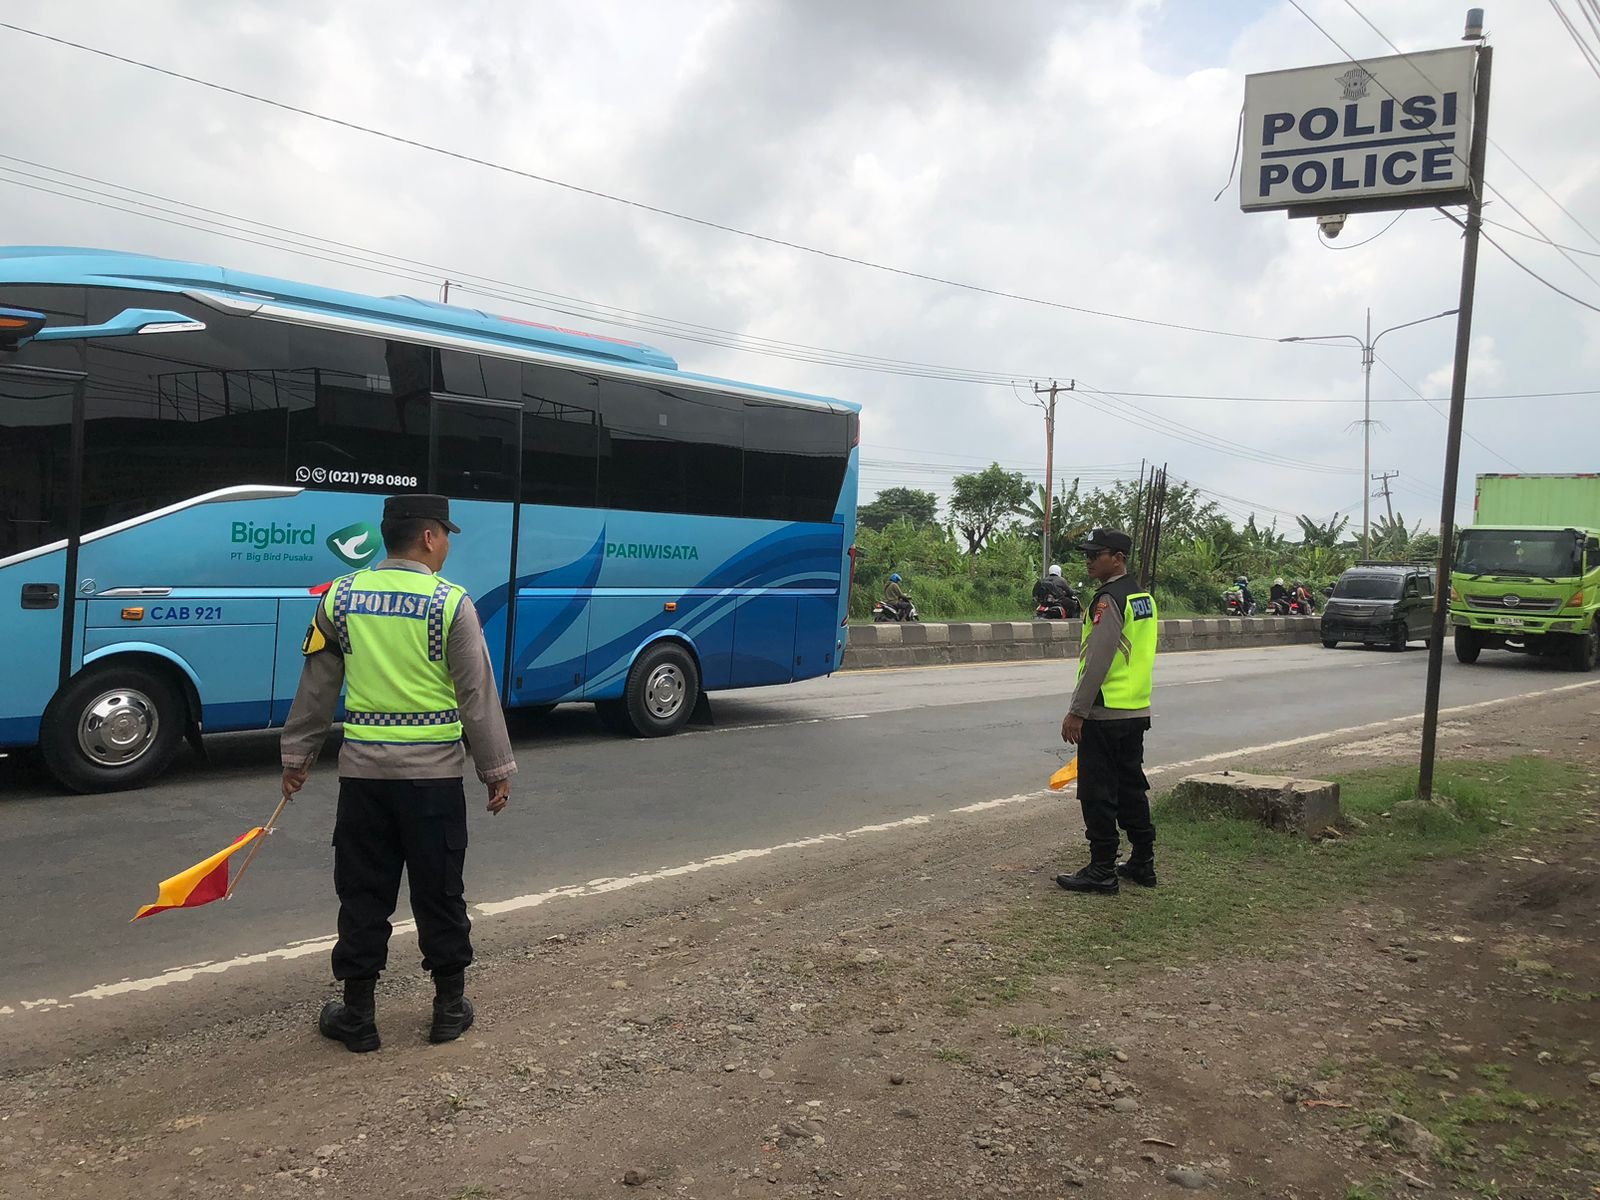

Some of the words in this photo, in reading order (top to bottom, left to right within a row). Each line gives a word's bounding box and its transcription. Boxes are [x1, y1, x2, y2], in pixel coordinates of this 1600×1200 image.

[1262, 91, 1457, 146] POLISI
[1259, 146, 1454, 197] POLICE
[328, 470, 359, 485] (021)
[361, 473, 385, 485] 798
[386, 475, 418, 487] 0808
[231, 521, 315, 549] Bigbird
[230, 552, 242, 560] PT
[246, 552, 261, 562] Big
[263, 552, 281, 561] Bird
[283, 553, 313, 561] Pusaka
[606, 543, 699, 560] PARIWISATA
[150, 607, 190, 620] CAB
[195, 607, 222, 620] 921
[349, 593, 428, 616] POLISI
